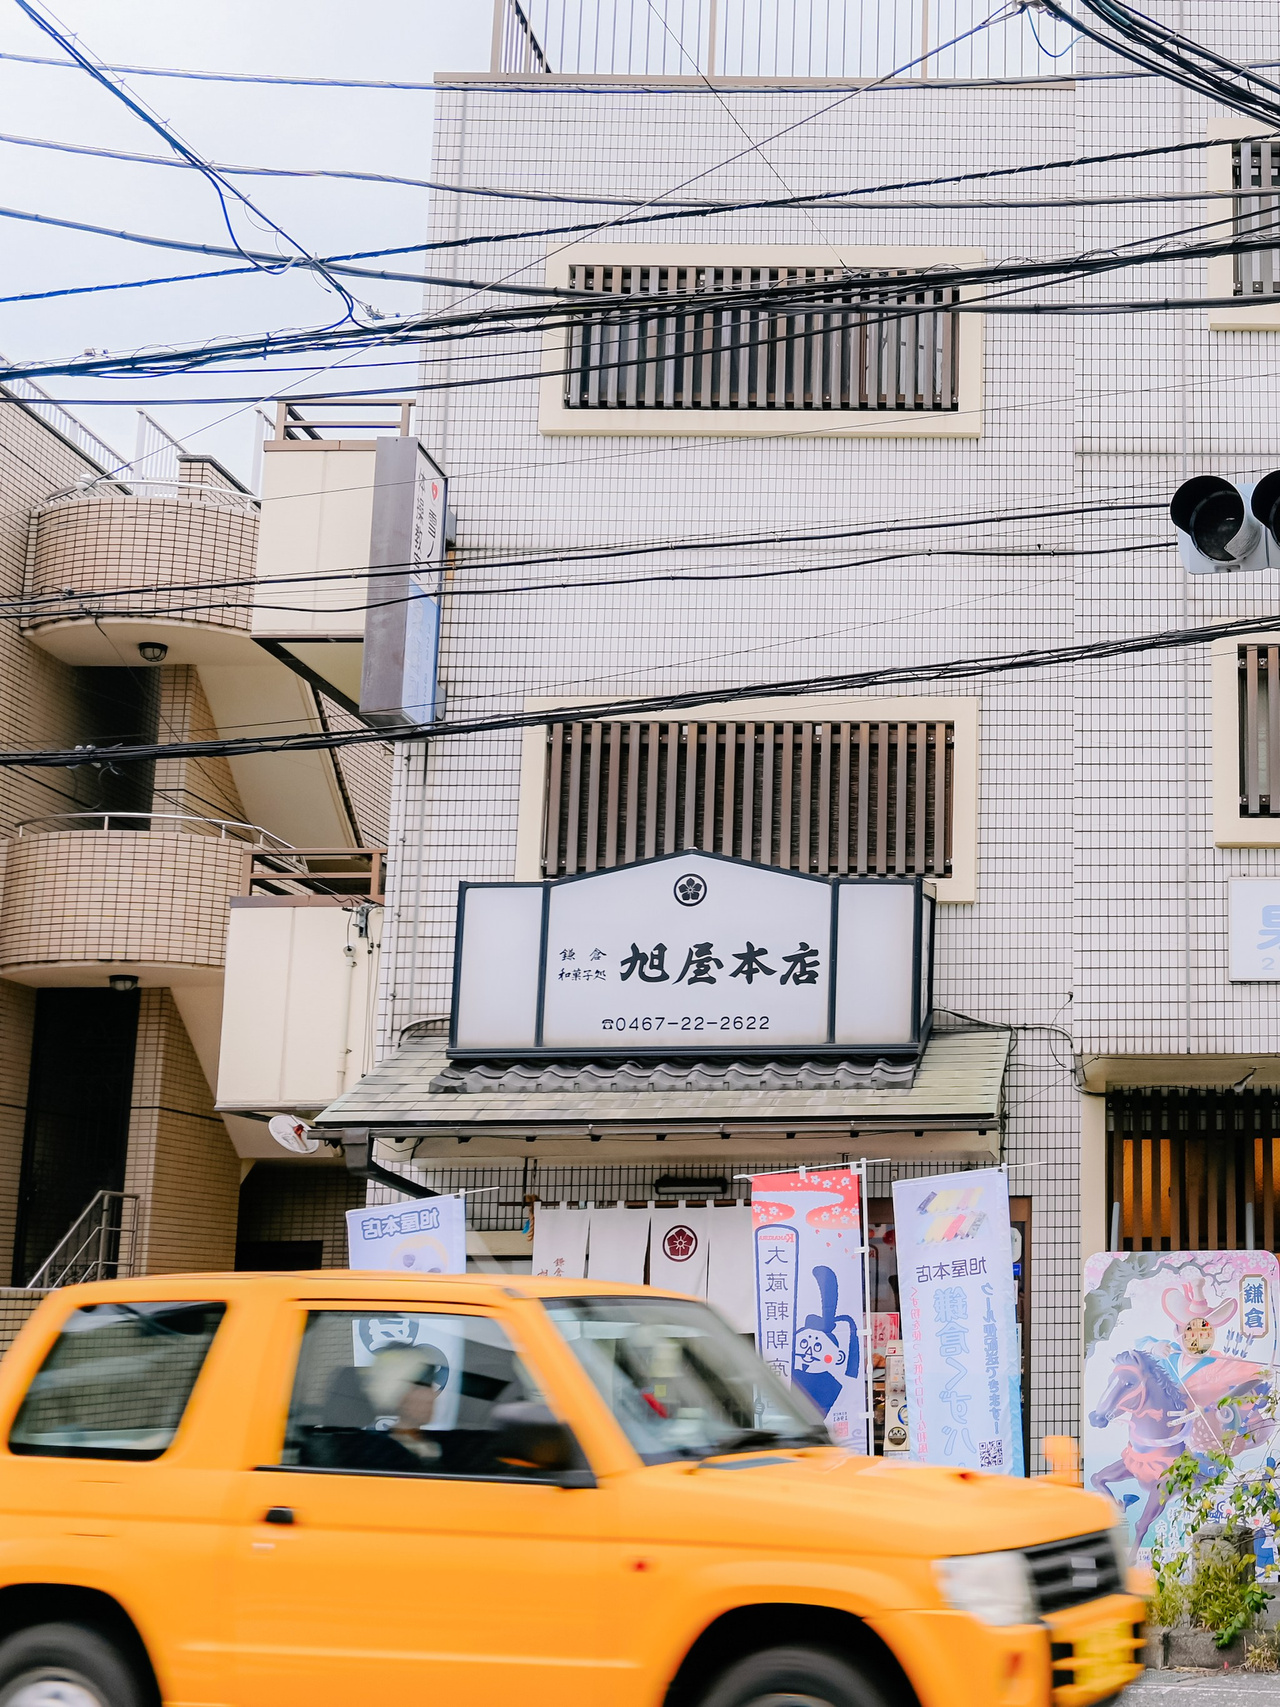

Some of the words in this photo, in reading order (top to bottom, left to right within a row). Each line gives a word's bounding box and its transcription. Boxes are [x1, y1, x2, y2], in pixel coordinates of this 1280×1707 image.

[559, 947, 608, 962] 鎌倉
[620, 941, 821, 986] 旭屋本店
[557, 967, 607, 982] 和菓子処
[615, 1014, 770, 1032] 0467-22-2622
[1243, 1282, 1265, 1329] 鎌倉
